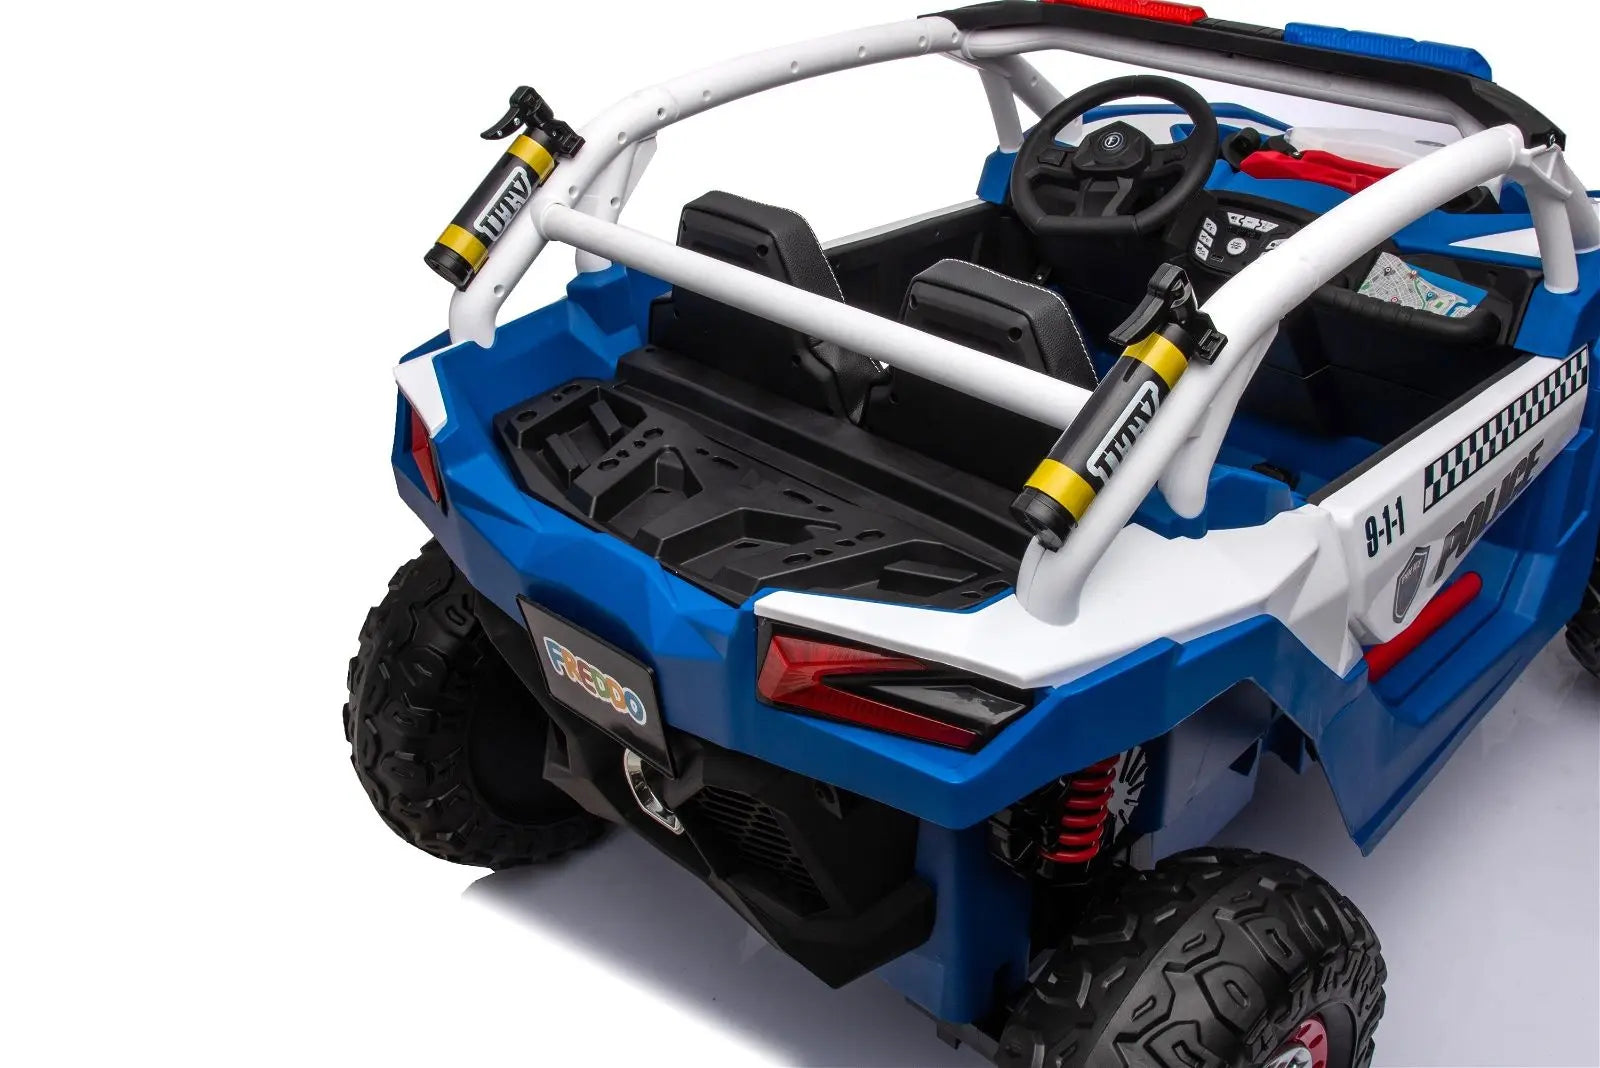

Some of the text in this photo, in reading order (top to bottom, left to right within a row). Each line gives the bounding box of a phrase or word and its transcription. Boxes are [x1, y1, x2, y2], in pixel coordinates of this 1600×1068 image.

[478, 171, 529, 237] UTV
[1365, 495, 1405, 558] 9-1-1
[1433, 438, 1545, 584] POLICE
[543, 637, 647, 725] FREDDO
